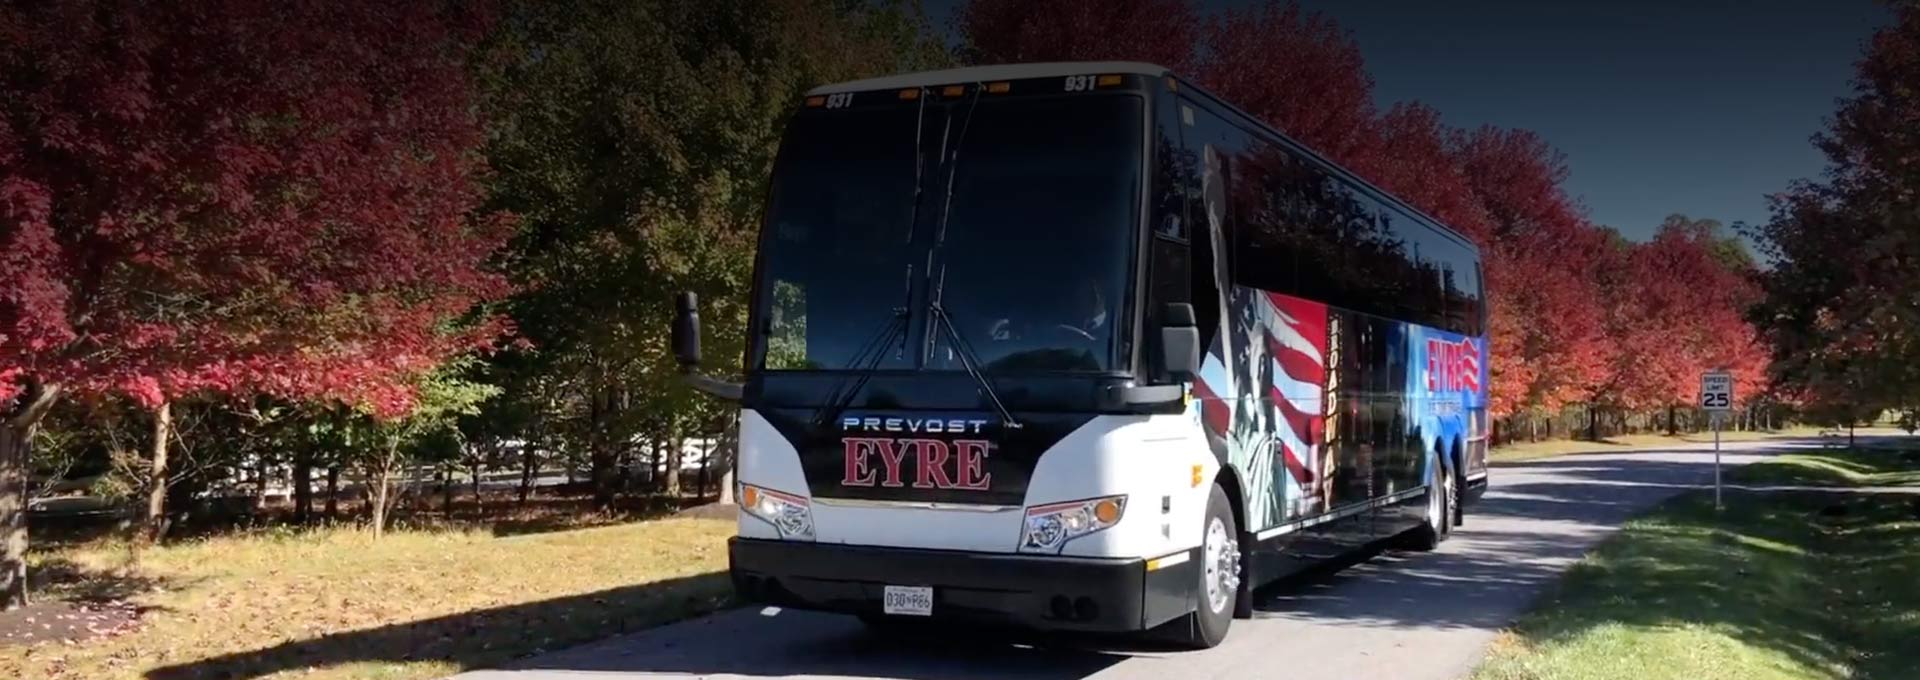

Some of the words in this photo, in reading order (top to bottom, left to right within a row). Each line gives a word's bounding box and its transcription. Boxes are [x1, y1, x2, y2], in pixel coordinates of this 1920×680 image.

[1064, 76, 1096, 92] 931
[825, 93, 854, 109] 931
[1427, 339, 1463, 393] EYRE
[1704, 393, 1729, 407] 25
[843, 417, 987, 433] PREVOST
[841, 437, 992, 491] EYRE
